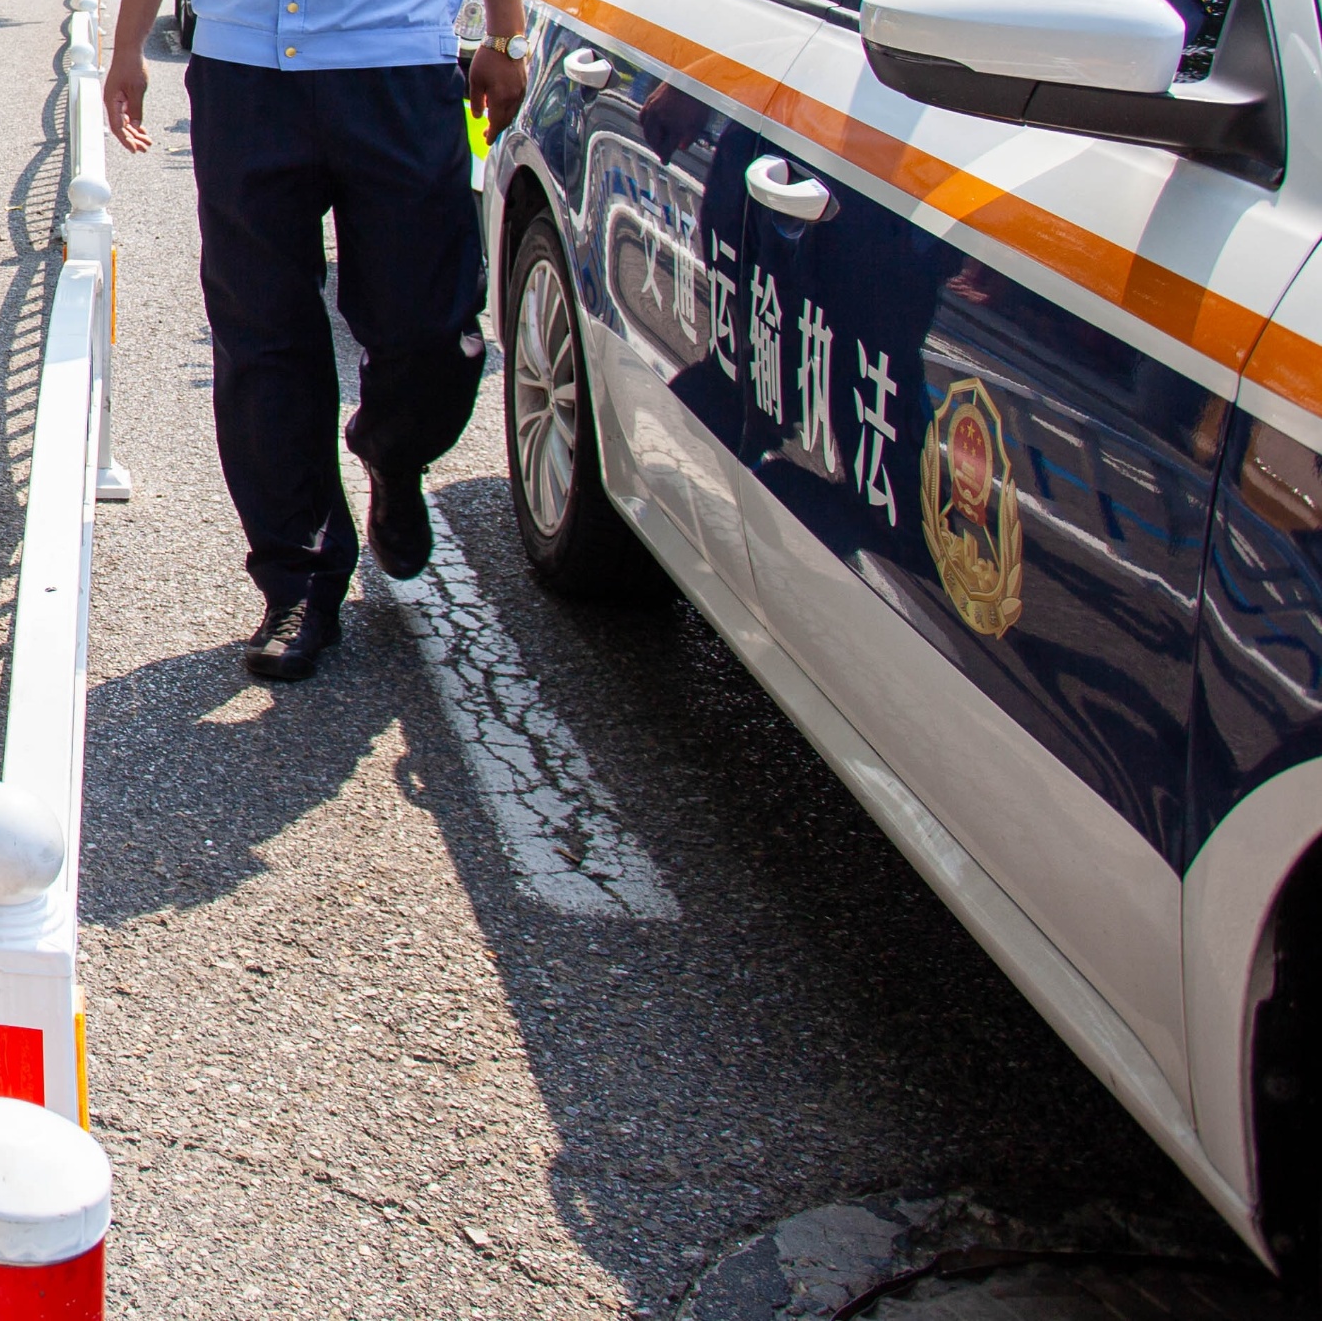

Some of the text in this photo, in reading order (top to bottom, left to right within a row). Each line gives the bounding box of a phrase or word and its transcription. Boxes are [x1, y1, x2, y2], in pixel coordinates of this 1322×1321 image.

[639, 191, 897, 527] 交通运输执法
